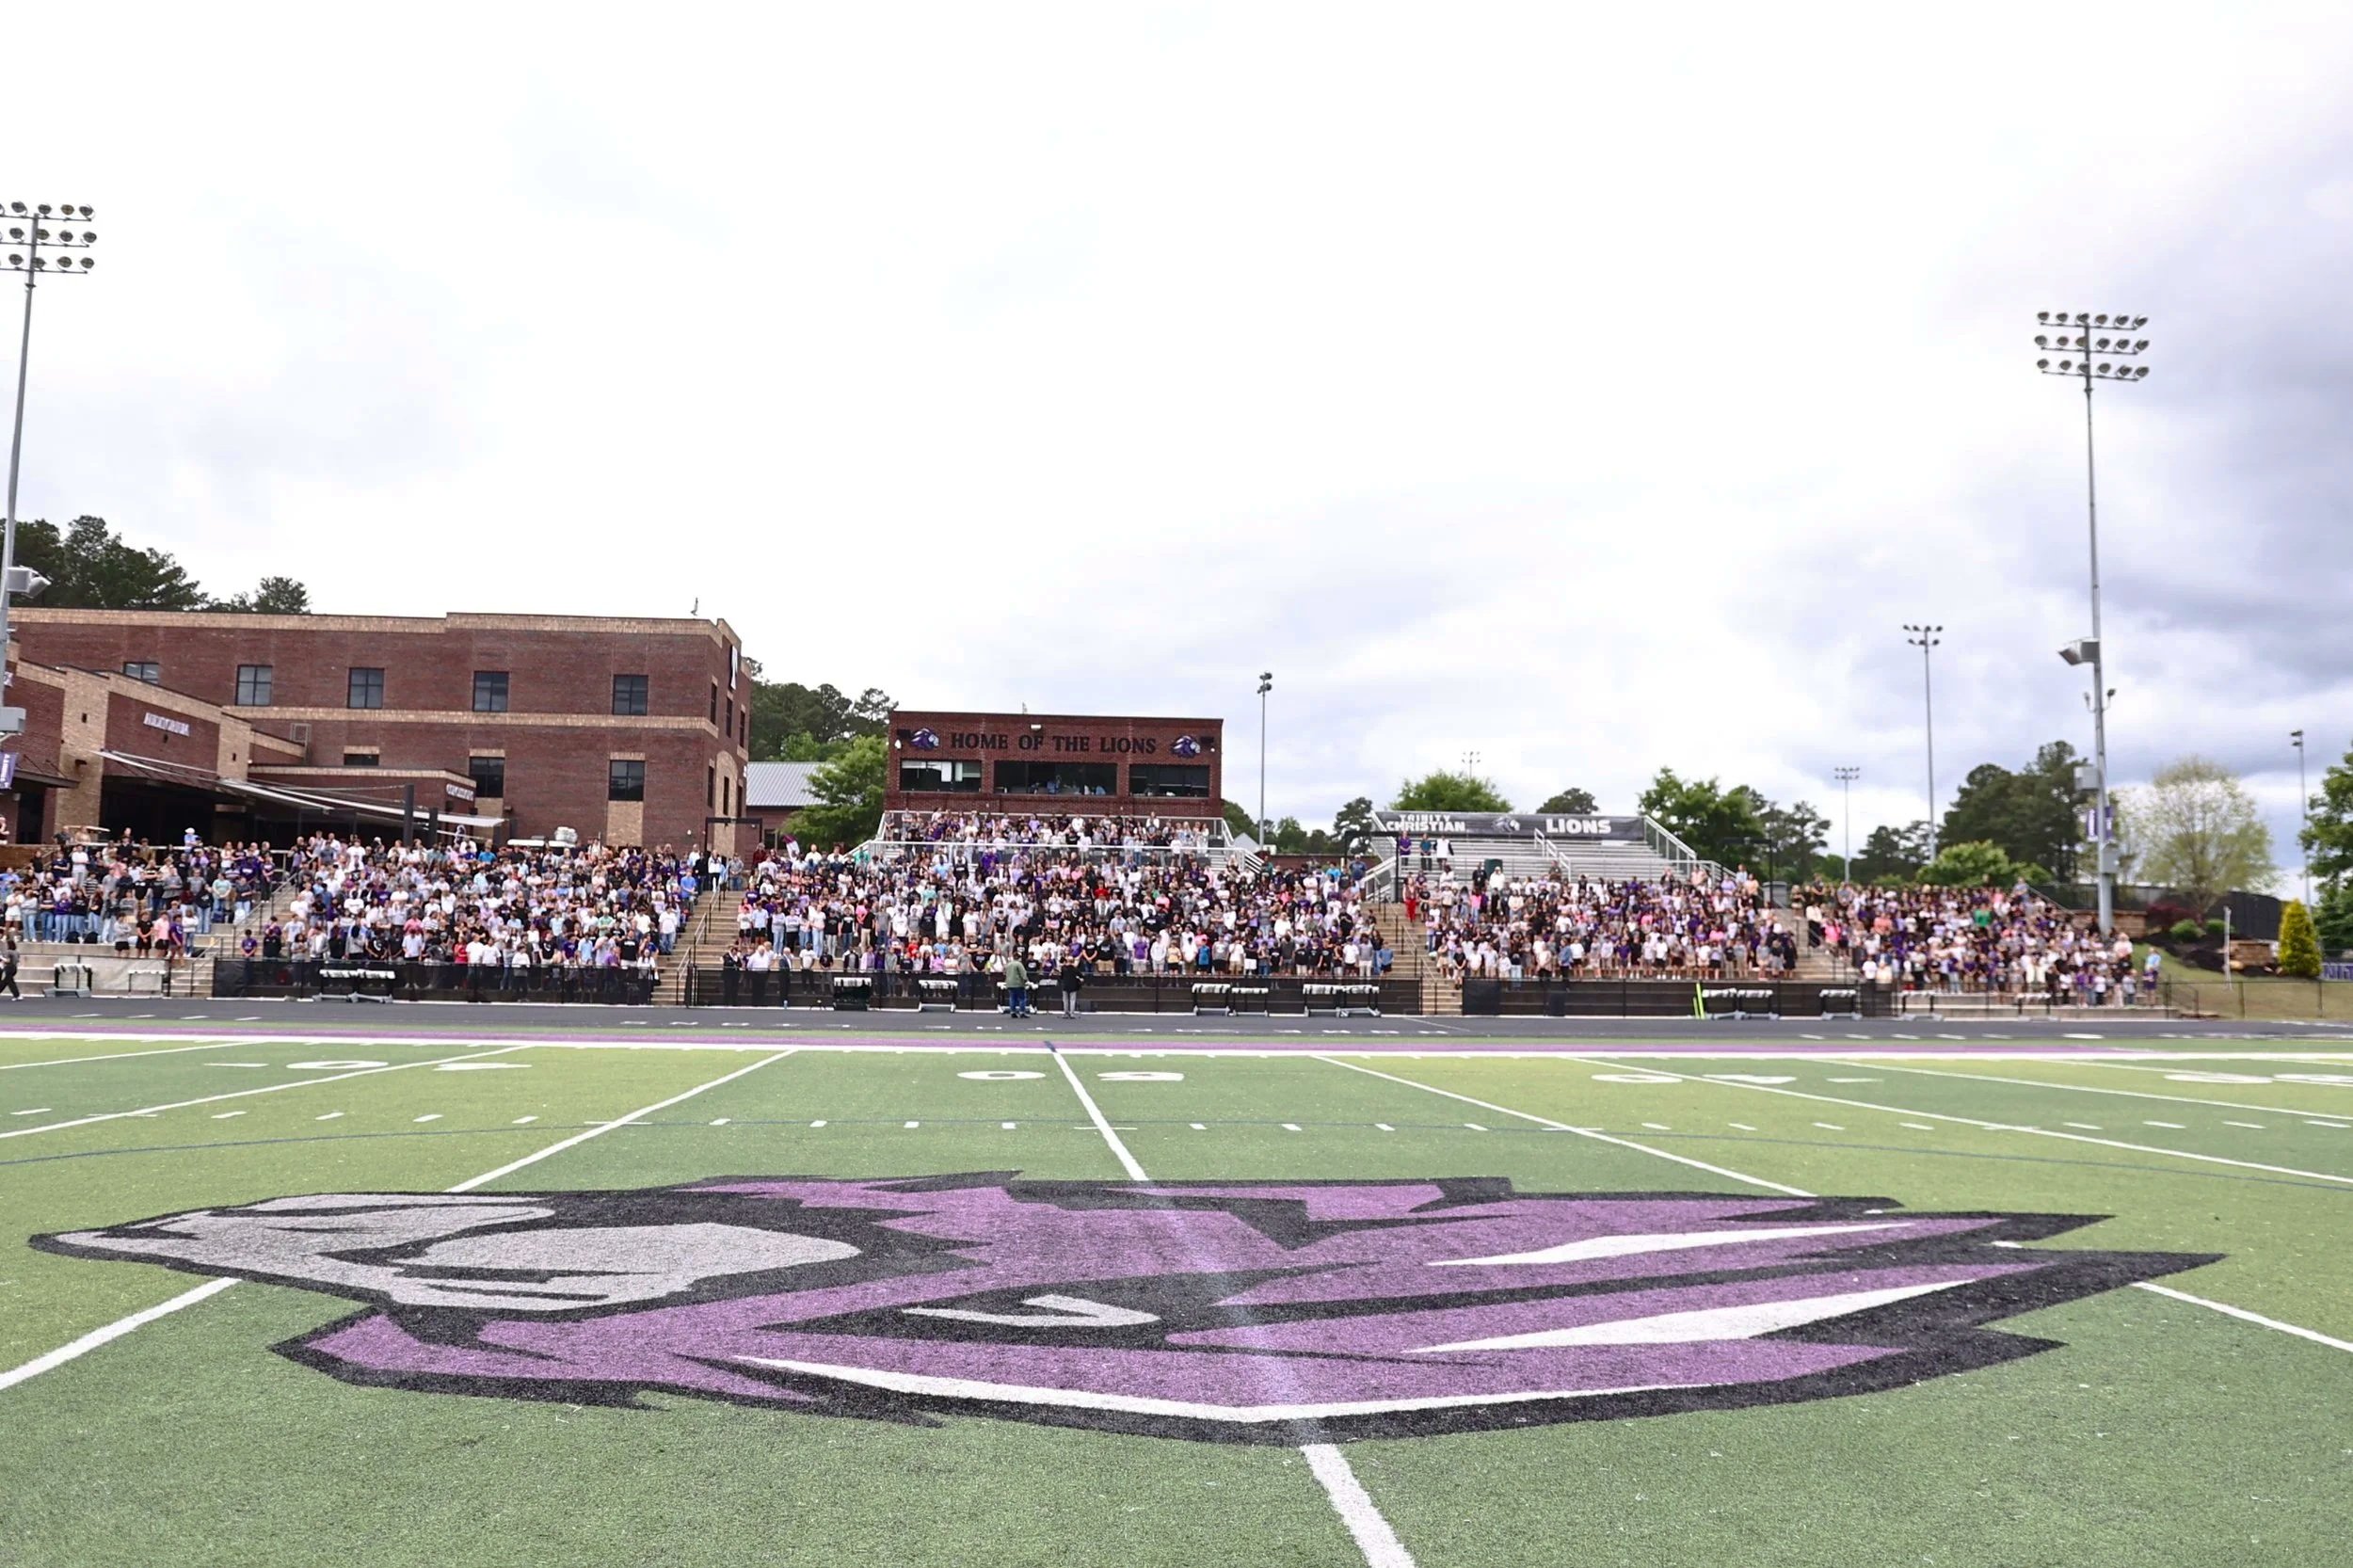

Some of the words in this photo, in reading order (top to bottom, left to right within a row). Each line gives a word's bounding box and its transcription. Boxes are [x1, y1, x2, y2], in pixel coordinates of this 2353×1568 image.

[952, 732, 1008, 750] HOME
[1018, 734, 1044, 751] OF
[1052, 735, 1089, 752] THE
[1099, 736, 1157, 754] LIONS
[1399, 813, 1450, 822] TRINITY
[1385, 821, 1465, 832] CHRISTIAN
[1545, 818, 1612, 834] LIONS
